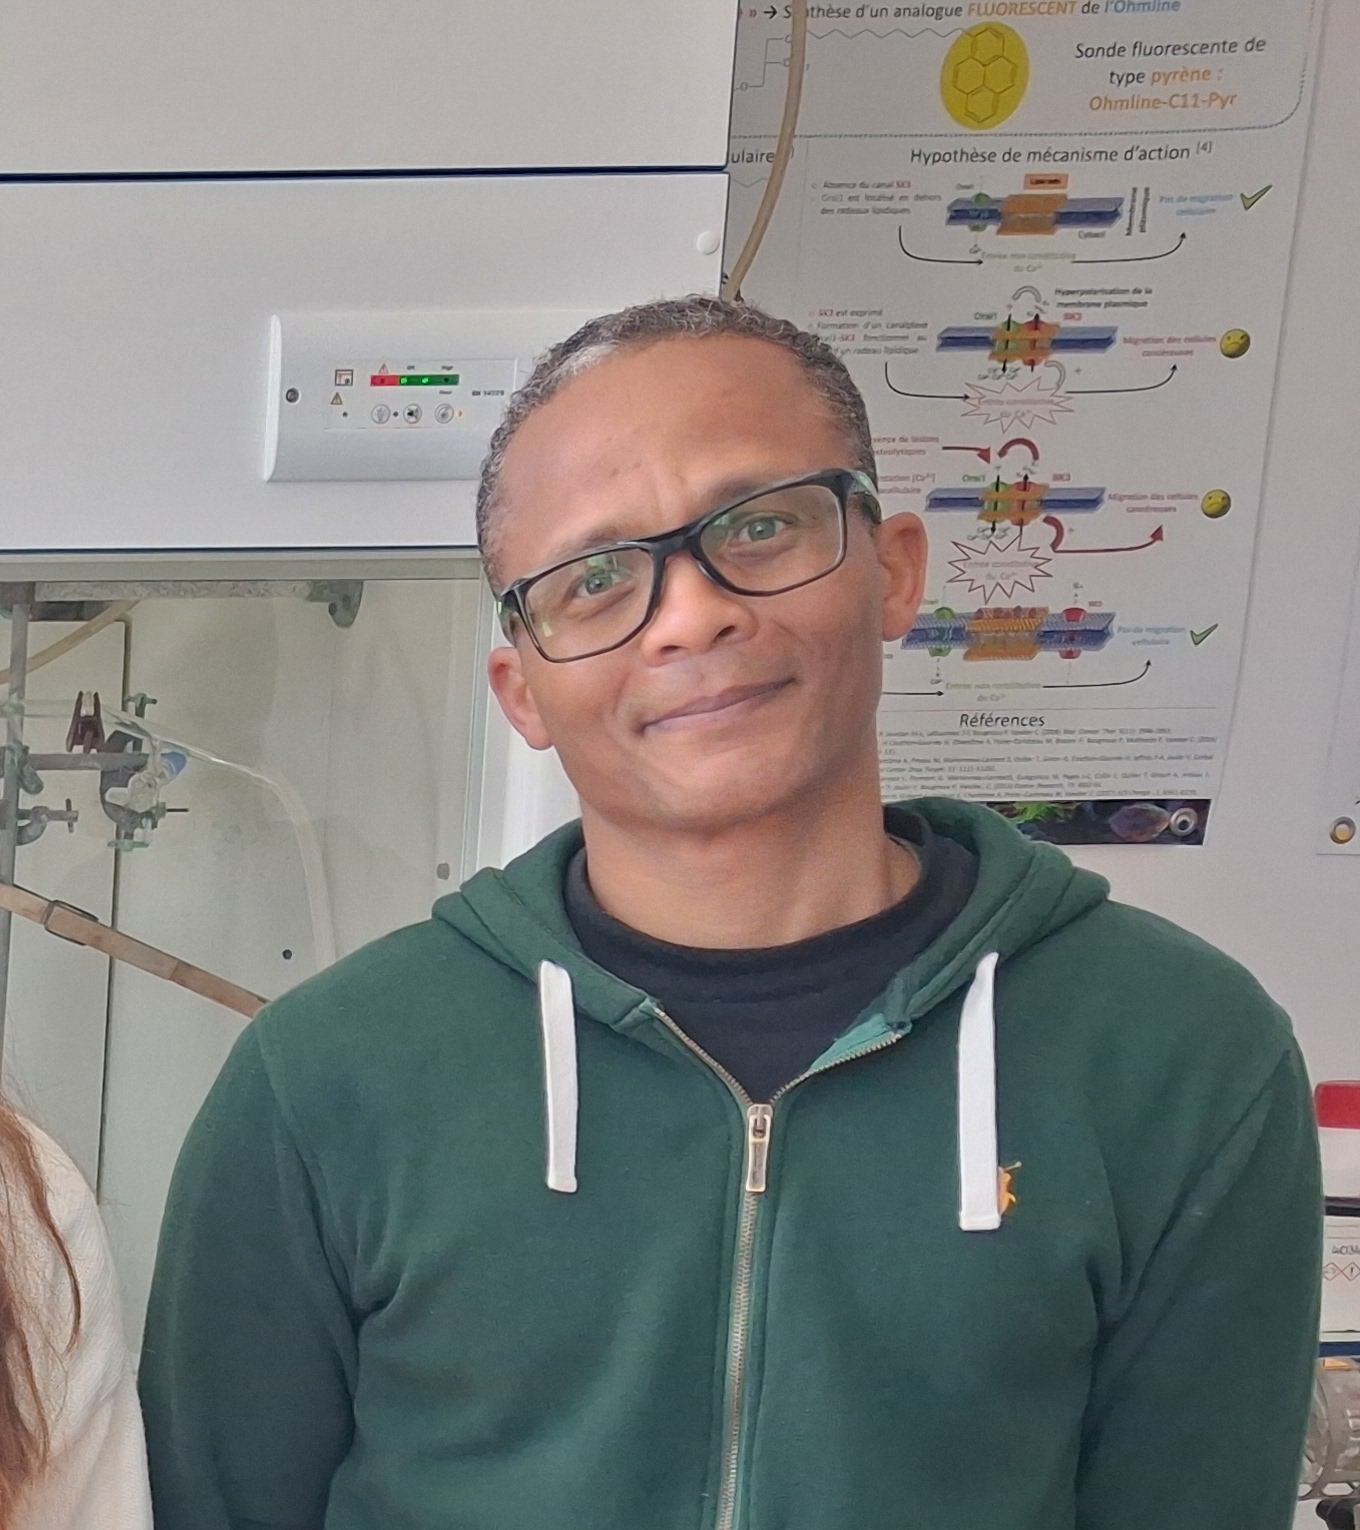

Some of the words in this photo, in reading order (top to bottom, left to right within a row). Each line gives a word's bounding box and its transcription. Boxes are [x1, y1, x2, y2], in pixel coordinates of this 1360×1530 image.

[783, 4, 850, 19] Sthèse
[855, 4, 888, 18] d'un
[893, 3, 963, 20] analogue
[968, 1, 1076, 16] FLUORESCENT
[1081, 0, 1101, 14] de
[1075, 42, 1126, 59] Sonde
[1131, 40, 1238, 57] fluorescente
[1244, 37, 1266, 52] de
[1109, 70, 1145, 88] type
[1150, 66, 1211, 87] pyrène
[1089, 91, 1238, 111] Ohmline-C11-Pyr
[910, 146, 996, 166] Hypothèse
[1002, 148, 1022, 163] de
[1027, 146, 1118, 163] mécanisme
[1123, 144, 1190, 161] d'action
[959, 713, 1046, 728] Références
